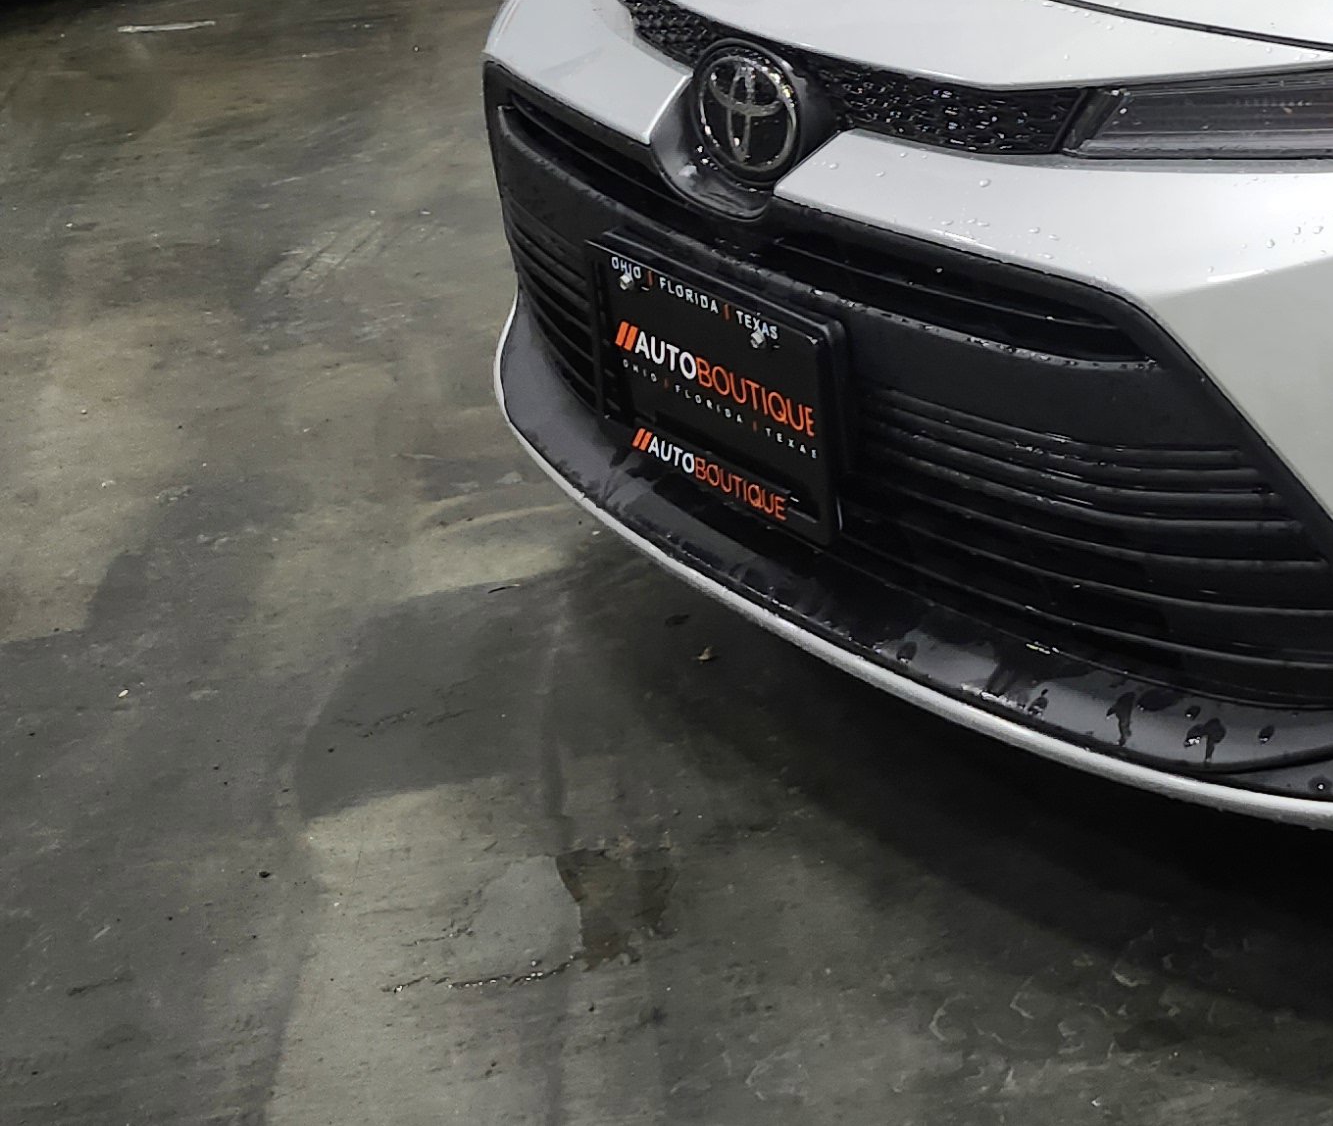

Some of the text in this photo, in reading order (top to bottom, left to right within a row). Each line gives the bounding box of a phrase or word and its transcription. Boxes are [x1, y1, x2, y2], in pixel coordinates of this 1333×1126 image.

[611, 256, 779, 340] OHIO FLORIDA TEXAS
